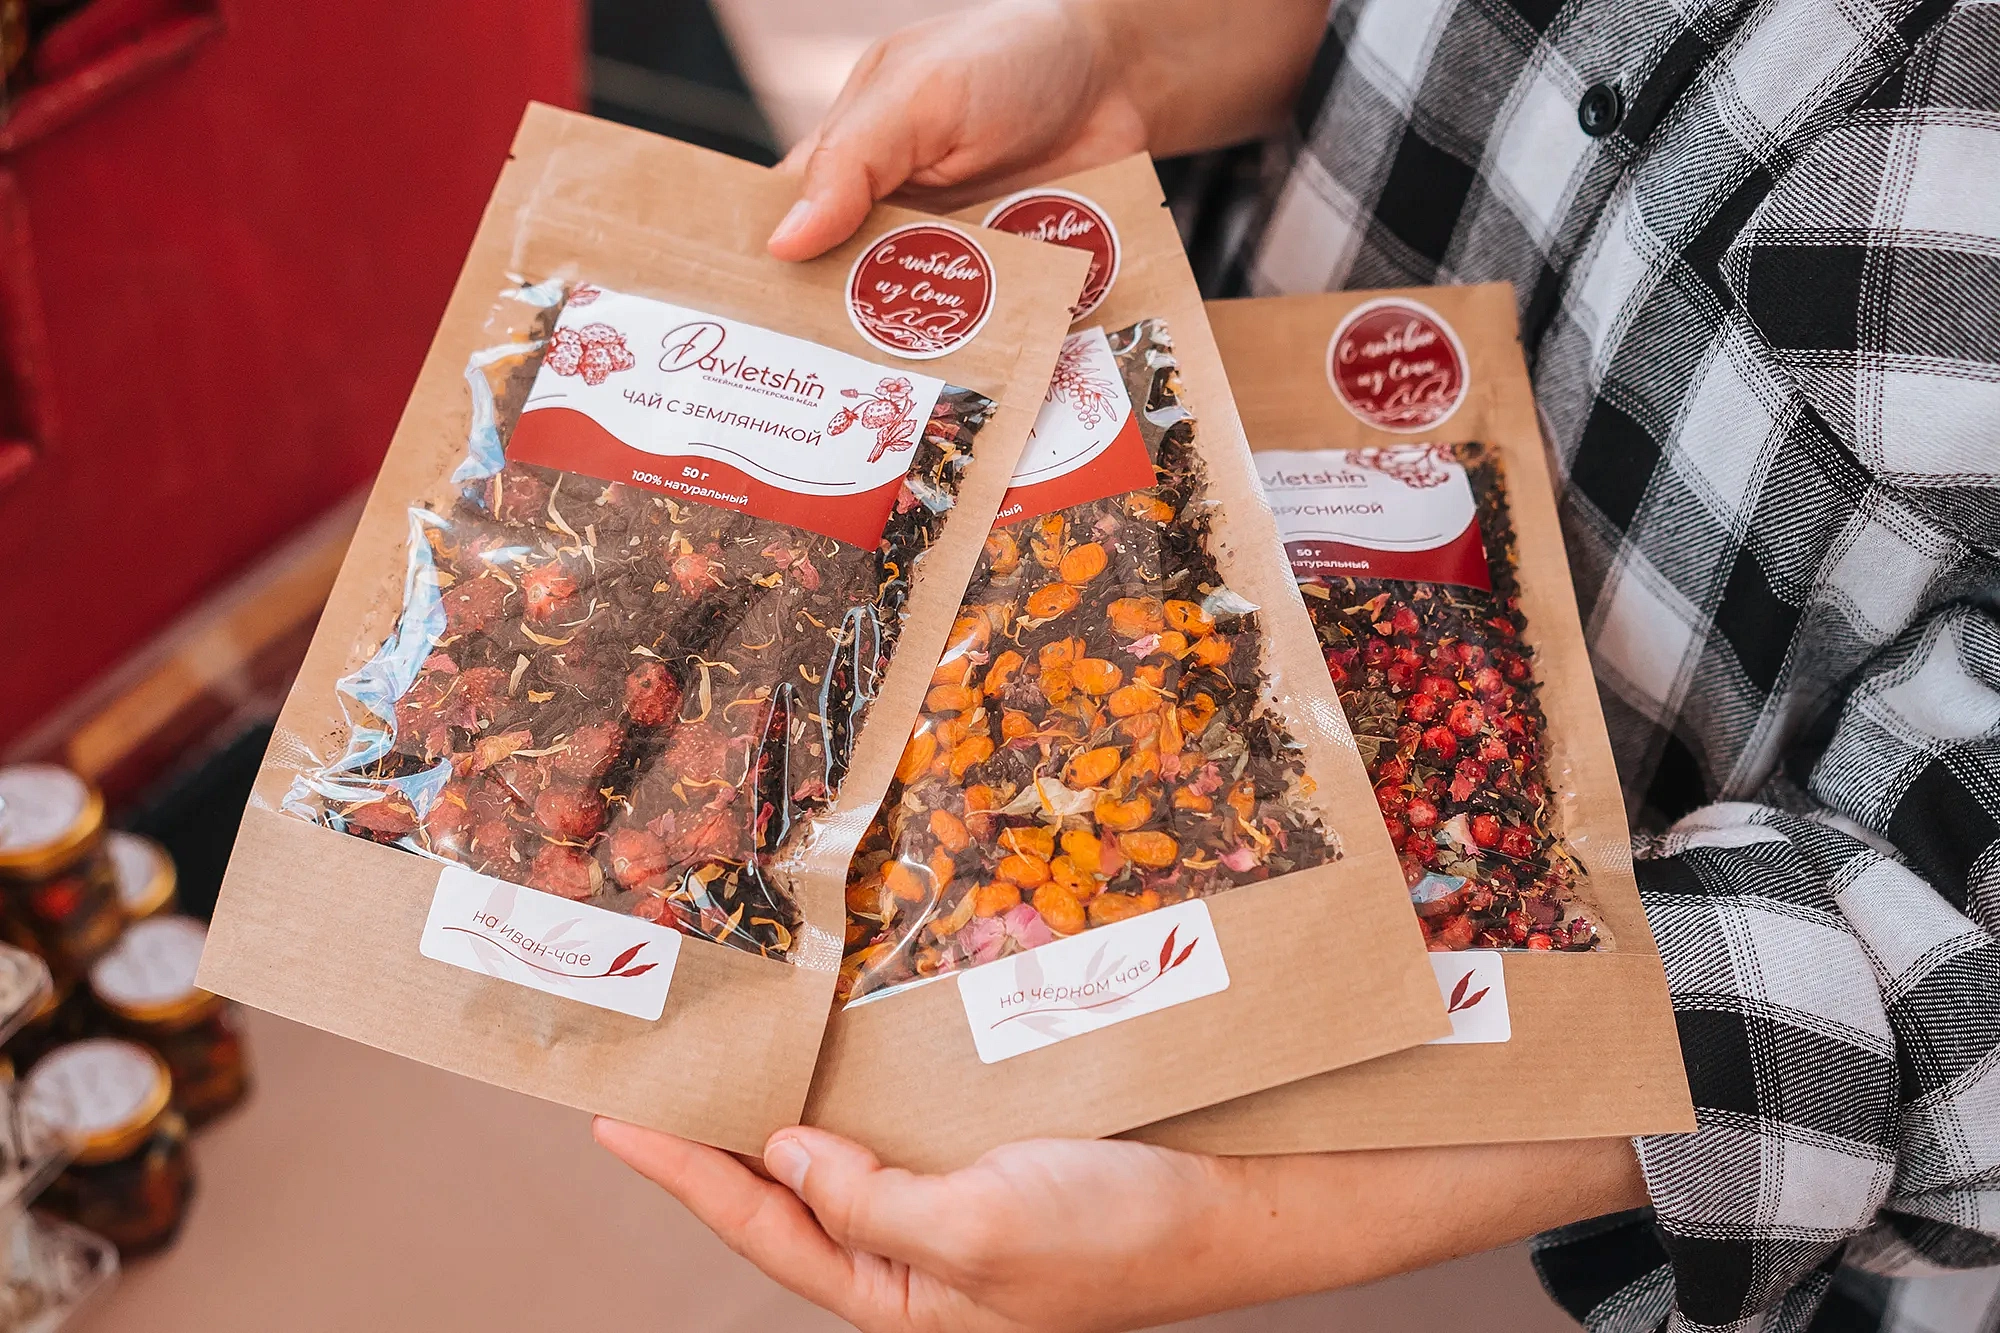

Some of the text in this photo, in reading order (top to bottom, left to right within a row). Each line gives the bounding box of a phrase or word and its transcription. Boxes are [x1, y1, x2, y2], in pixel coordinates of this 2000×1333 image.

[875, 244, 897, 264] С
[874, 280, 965, 308] из Сочи
[658, 321, 826, 400] Davletshin
[702, 374, 744, 389] СЕМЕЙНАЯ
[744, 386, 795, 402] МАСТЕРСКАЯ
[623, 388, 823, 447] ЧАЙ С ЗЕМЛЯНИКОЙ
[631, 470, 748, 505] 100% натуральный
[681, 466, 710, 481] 50 г
[1296, 548, 1322, 557] 50 г
[472, 910, 592, 966] на иван-чае
[1000, 959, 1151, 1008] на чёрном чае
